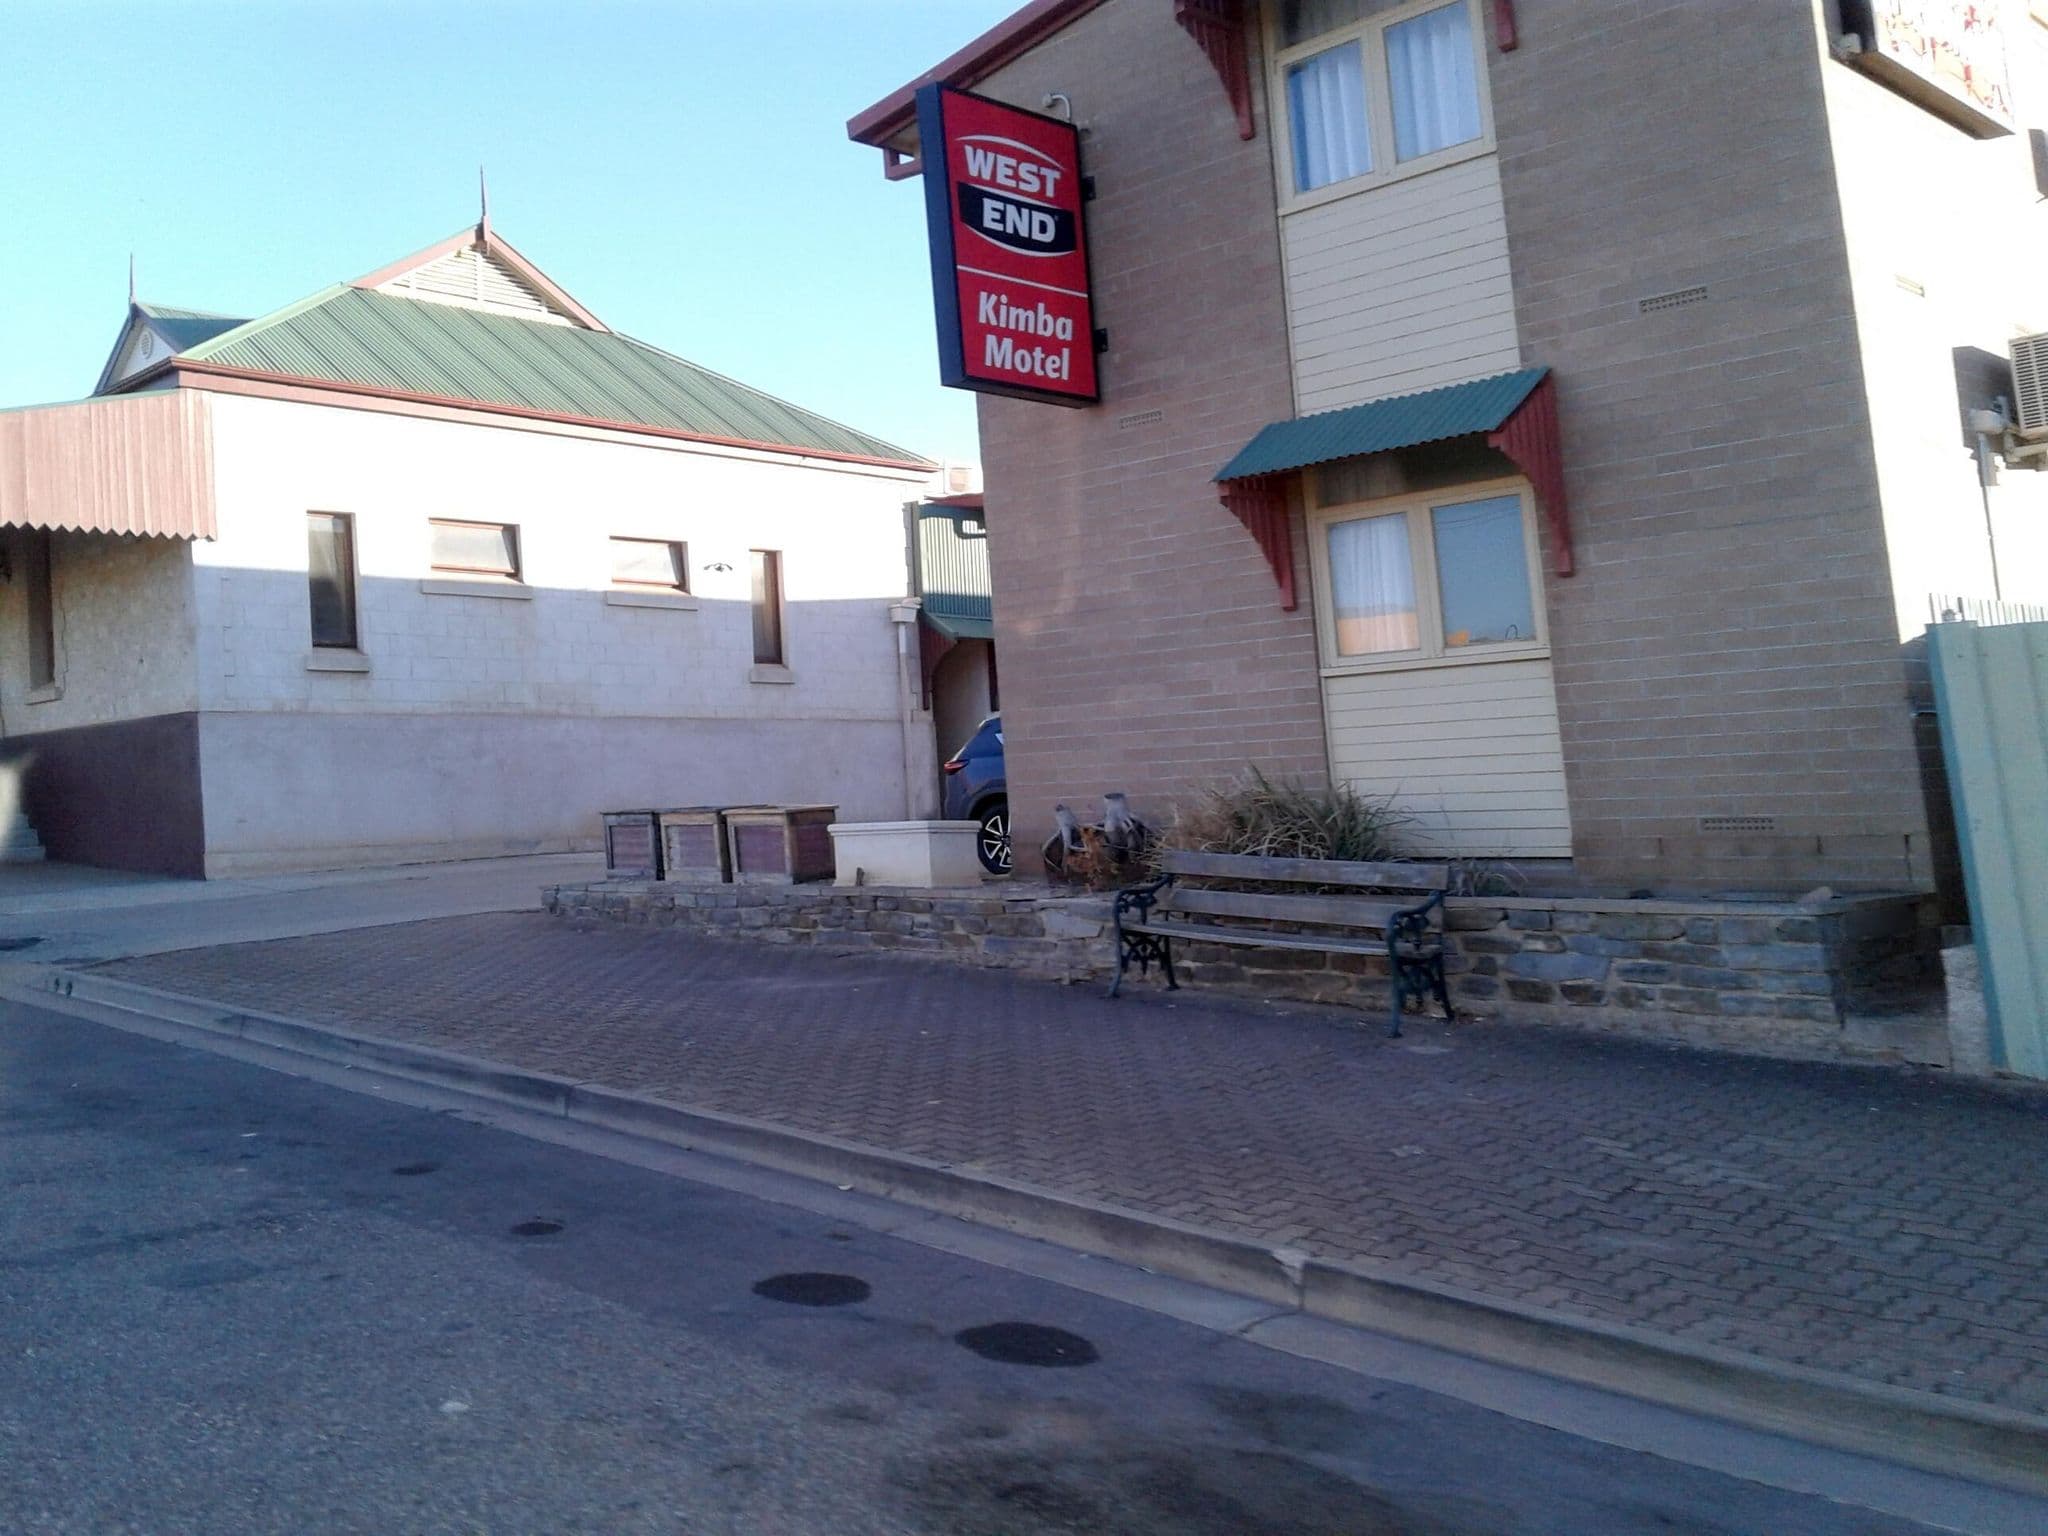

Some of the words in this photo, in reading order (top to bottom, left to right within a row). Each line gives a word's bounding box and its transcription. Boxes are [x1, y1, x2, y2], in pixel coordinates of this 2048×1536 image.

[964, 145, 1061, 198] WEST
[982, 197, 1056, 243] END
[978, 291, 1073, 341] Kimba
[985, 334, 1070, 381] Motel
